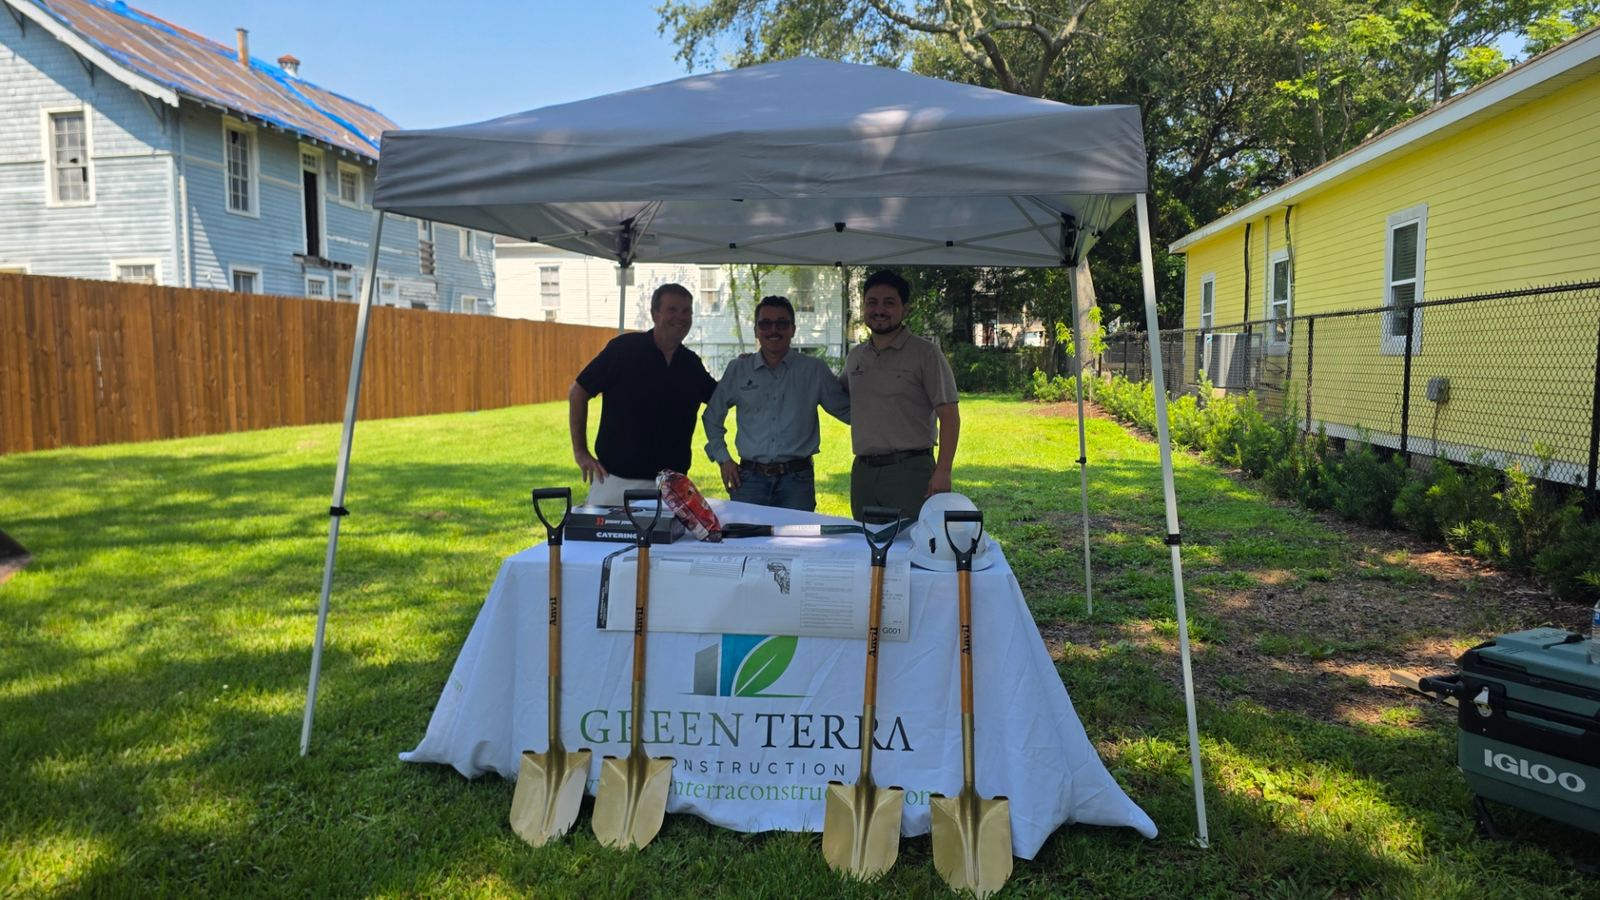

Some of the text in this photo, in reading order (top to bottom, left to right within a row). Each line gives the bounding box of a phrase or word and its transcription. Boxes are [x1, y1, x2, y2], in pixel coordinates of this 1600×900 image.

[596, 531, 638, 540] CATERING
[868, 627, 878, 657] Anvil
[961, 624, 971, 655] Anvil
[579, 709, 915, 752] GREEN TERRA
[652, 756, 846, 776] NSTRUCTION
[1484, 748, 1587, 793] IGLOO
